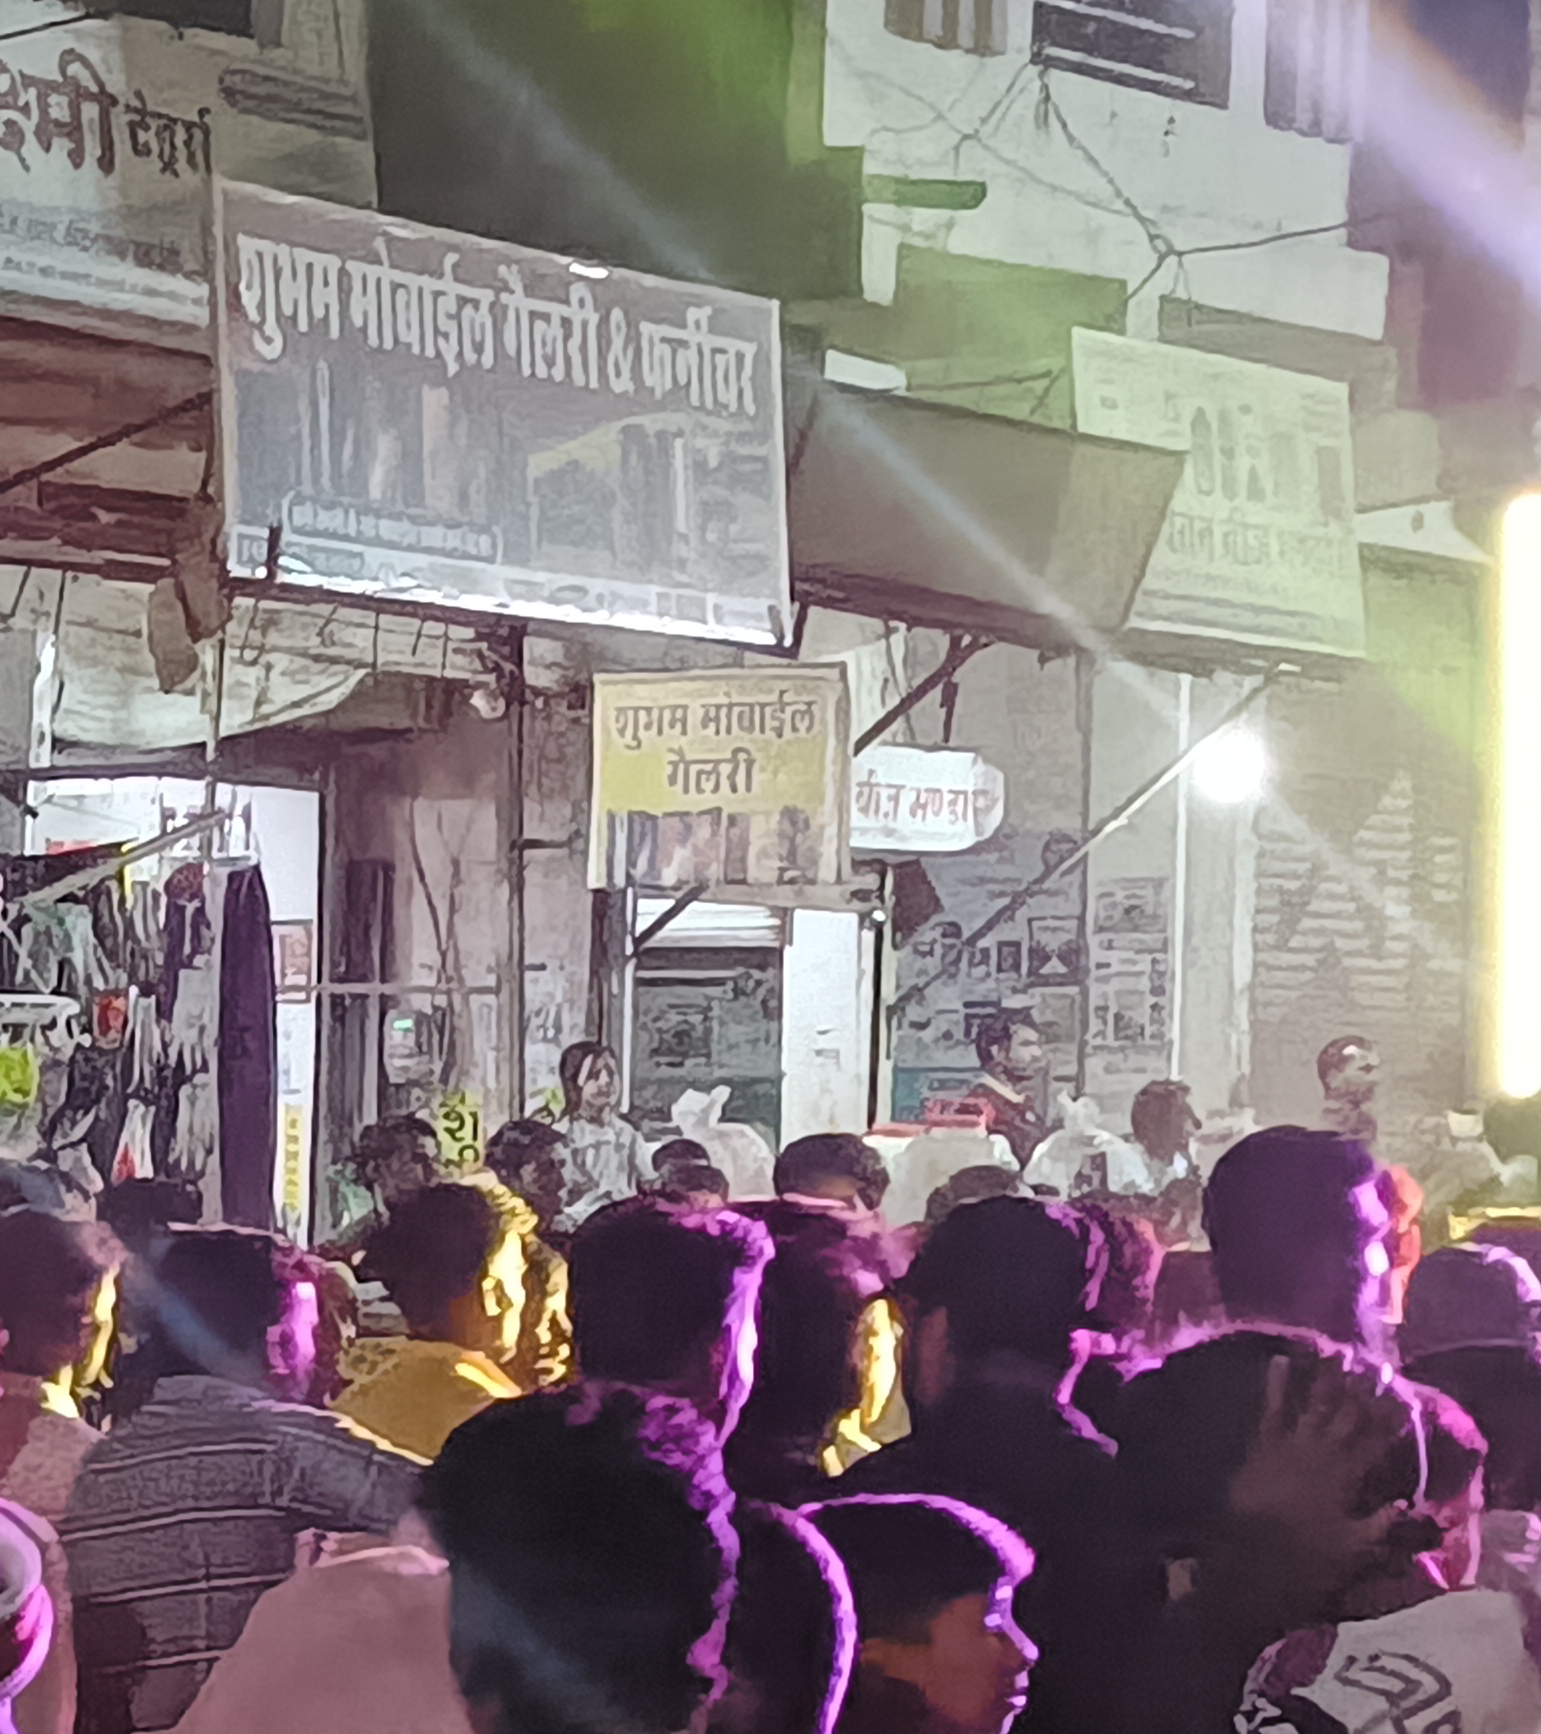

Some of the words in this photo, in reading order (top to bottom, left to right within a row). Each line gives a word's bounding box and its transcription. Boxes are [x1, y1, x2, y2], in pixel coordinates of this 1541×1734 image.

[236, 232, 342, 360] शुभम
[345, 236, 496, 378] मोबाईल
[499, 264, 600, 389] गैलरी
[607, 306, 635, 396] &
[639, 305, 758, 416] फर्नीचर
[700, 689, 818, 739] मोबाईल
[666, 744, 758, 795] गैलरी
